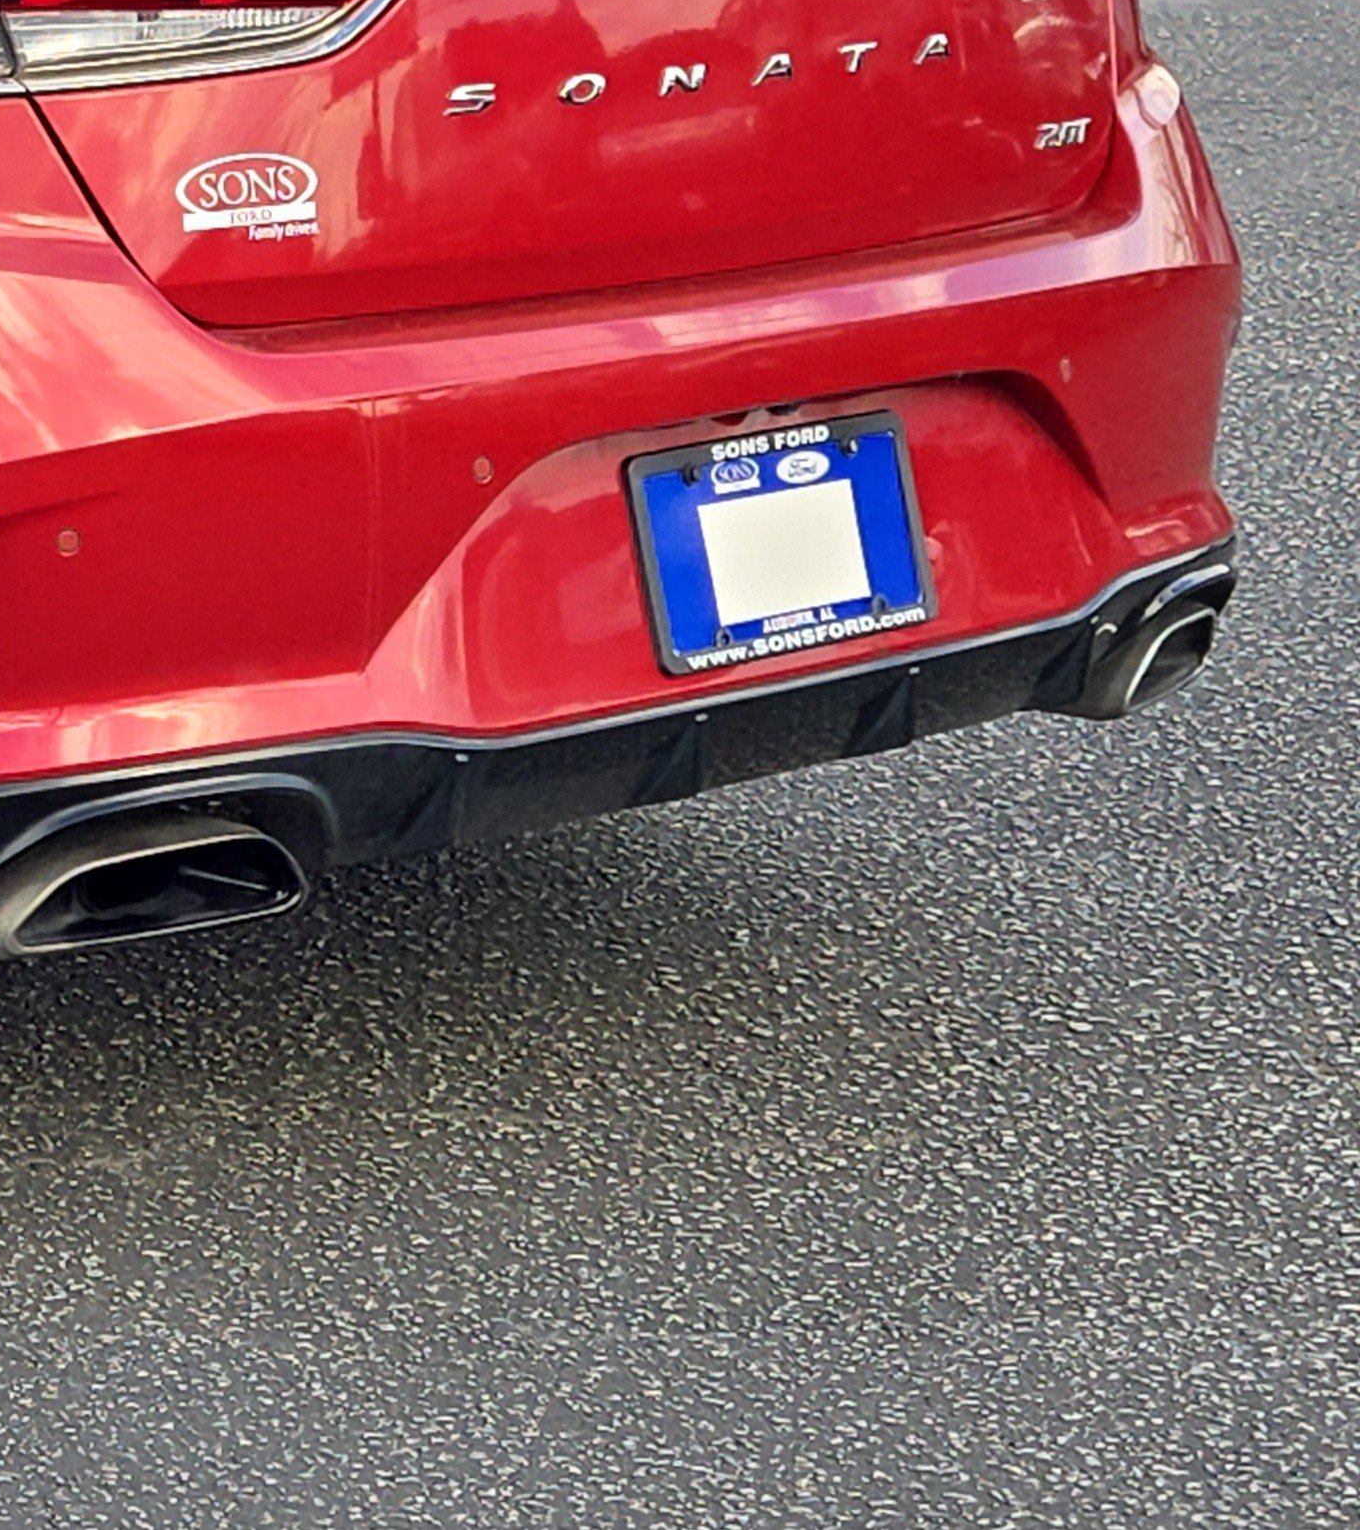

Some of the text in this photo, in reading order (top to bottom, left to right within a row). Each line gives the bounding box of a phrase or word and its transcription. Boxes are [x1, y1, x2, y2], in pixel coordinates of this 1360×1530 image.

[443, 33, 950, 116] SONATA
[198, 165, 297, 209] SONS
[710, 424, 830, 462] SONS FORD
[687, 605, 926, 671] www.SONSFORD.com
